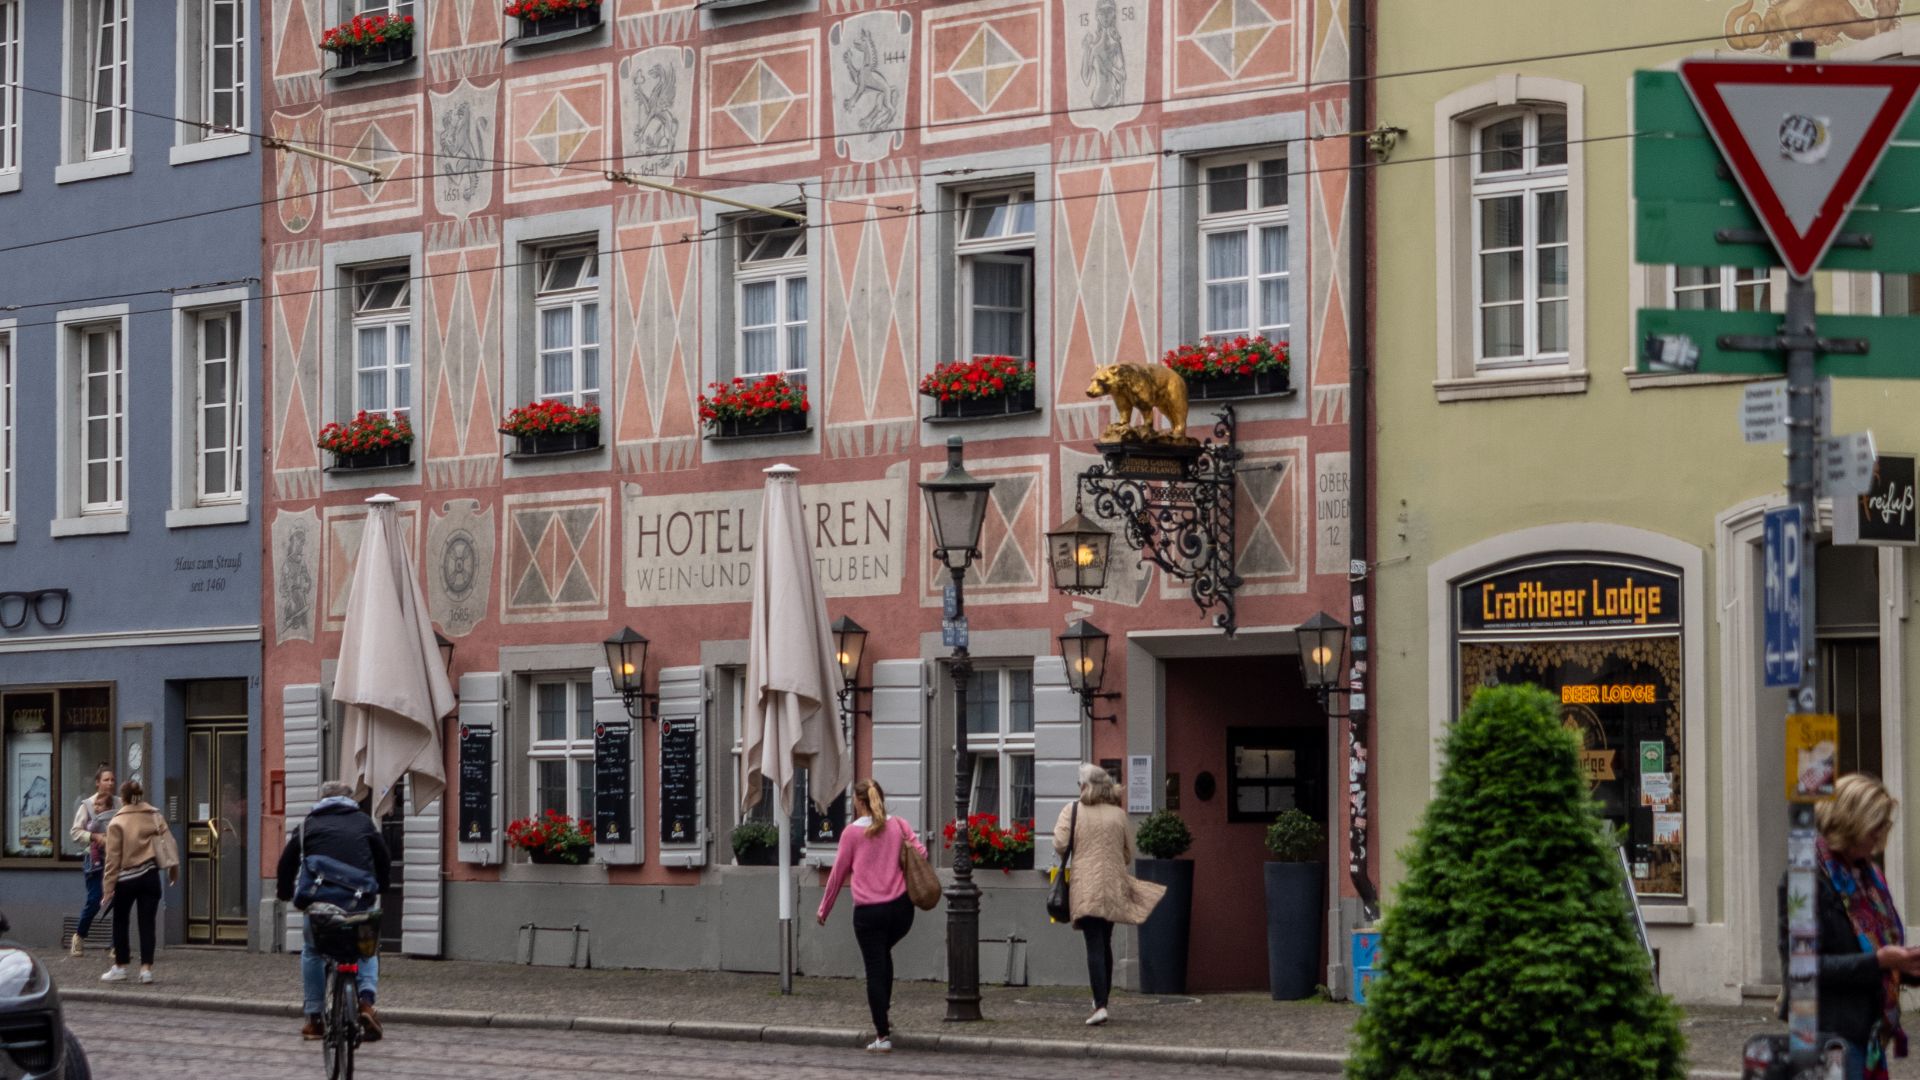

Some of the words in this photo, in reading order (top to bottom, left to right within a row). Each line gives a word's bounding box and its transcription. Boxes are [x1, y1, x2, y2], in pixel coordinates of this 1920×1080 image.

[883, 50, 906, 65] 1444
[444, 187, 460, 201] 1651
[1867, 481, 1914, 526] reifuß
[637, 508, 754, 558] HOTEL
[803, 498, 892, 549] REN
[1326, 525, 1341, 546] 12
[174, 556, 195, 572] Haus
[197, 559, 214, 571] zum
[215, 552, 243, 574] Strauß
[637, 560, 752, 592] WEIN-UND
[815, 554, 889, 583] TUBEN
[190, 579, 204, 593] seit
[205, 577, 226, 592] 1460
[1482, 580, 1586, 620] Craftbeer
[1592, 577, 1662, 625] Lodge
[250, 675, 260, 689] 14
[1561, 685, 1600, 704] BEER
[1601, 684, 1657, 704] LODGE
